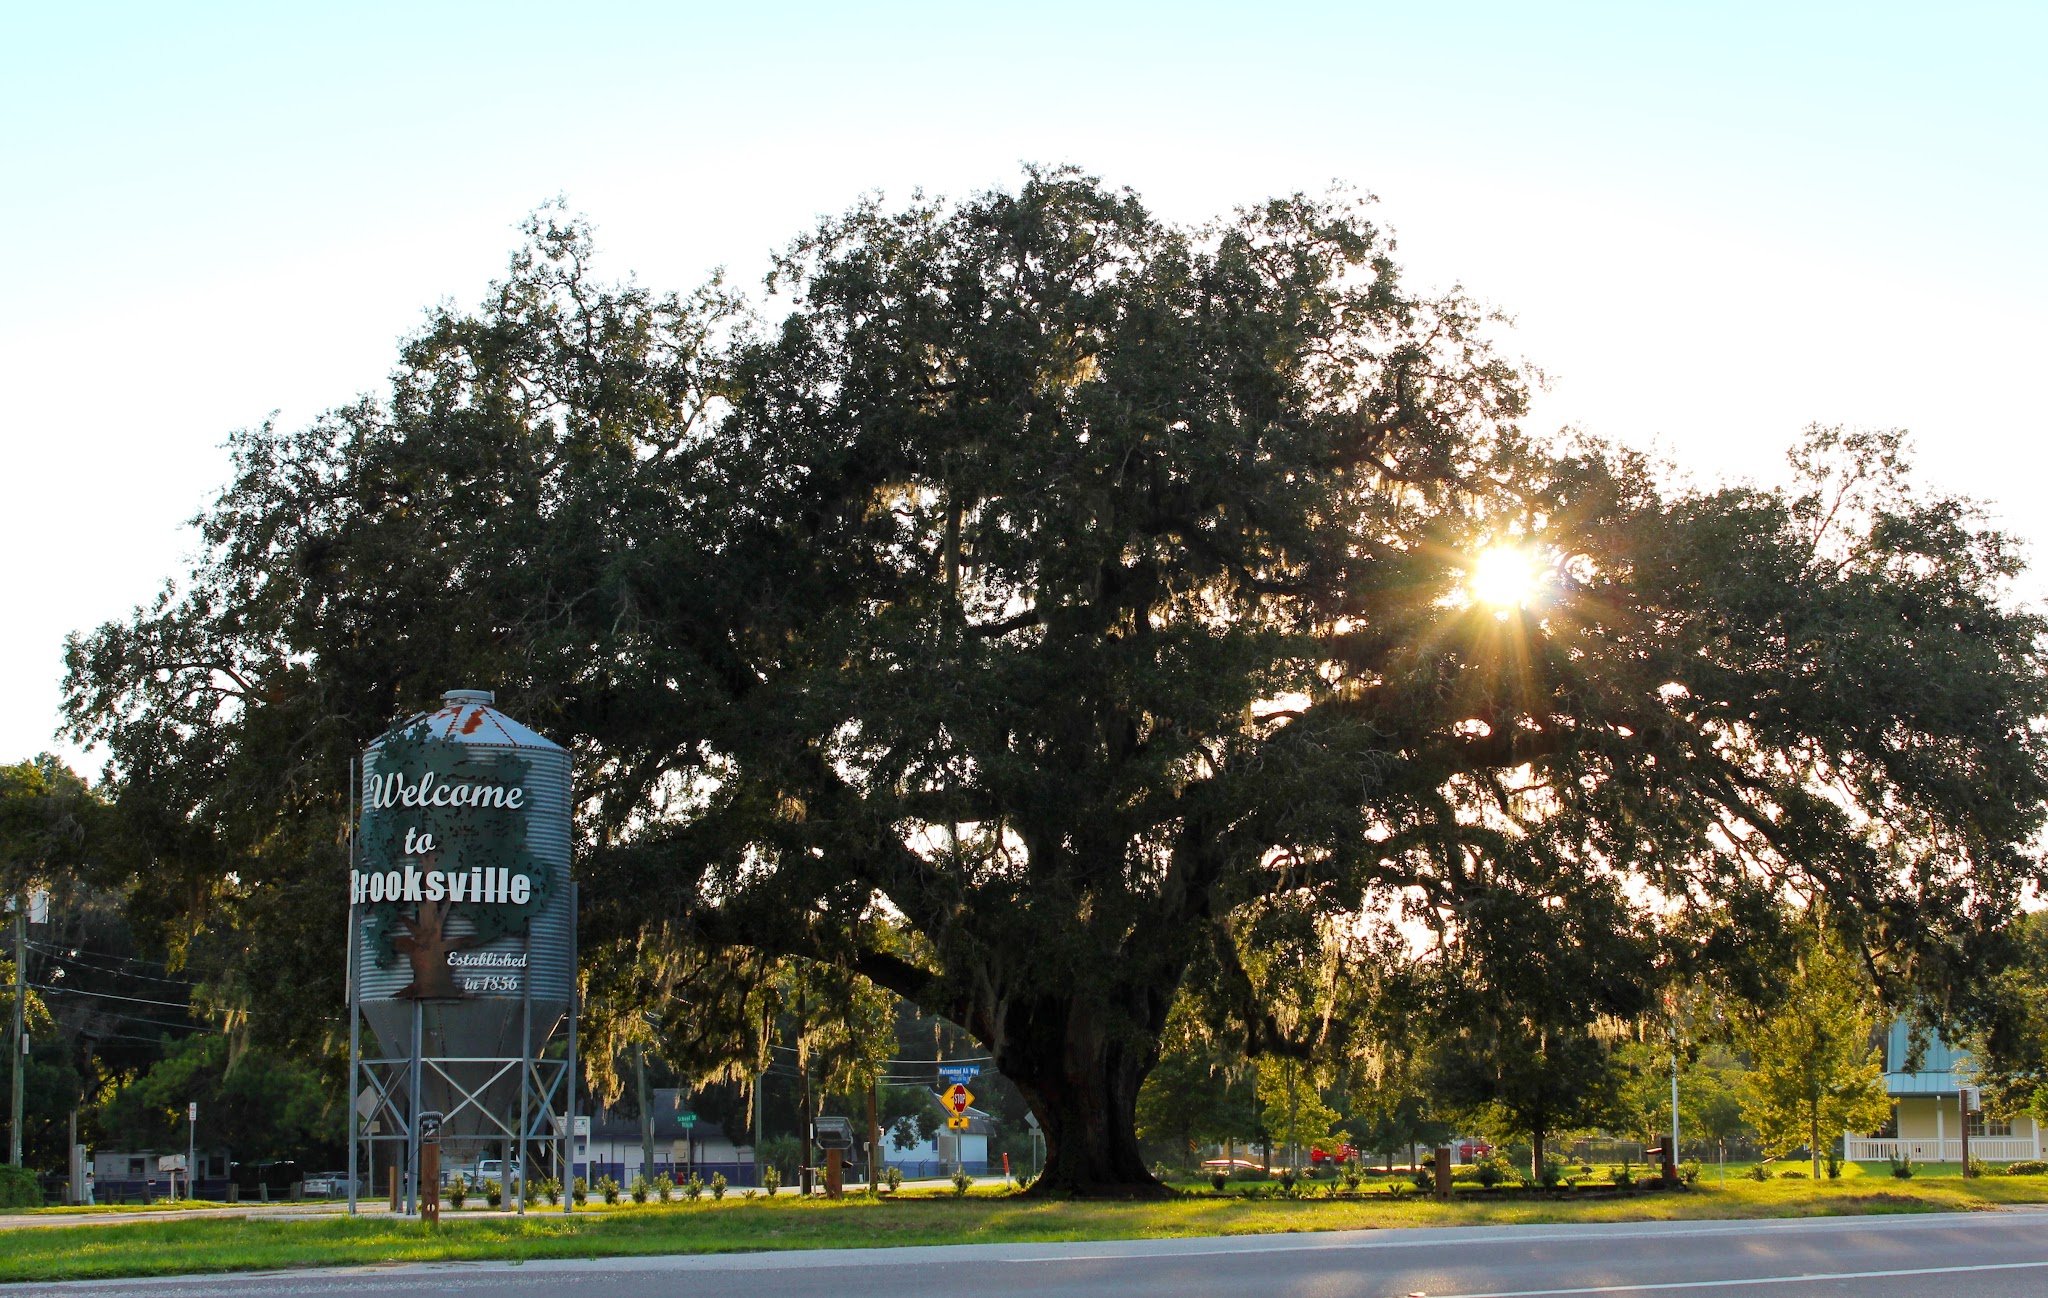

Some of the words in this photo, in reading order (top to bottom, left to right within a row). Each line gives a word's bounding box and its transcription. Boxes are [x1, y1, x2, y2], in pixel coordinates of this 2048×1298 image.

[370, 772, 523, 809] Welcome
[405, 827, 435, 854] to
[351, 866, 531, 904] Brooksville
[447, 951, 527, 967] Established
[464, 978, 479, 990] in
[482, 976, 518, 990] 1856
[954, 1093, 965, 1104] STOP
